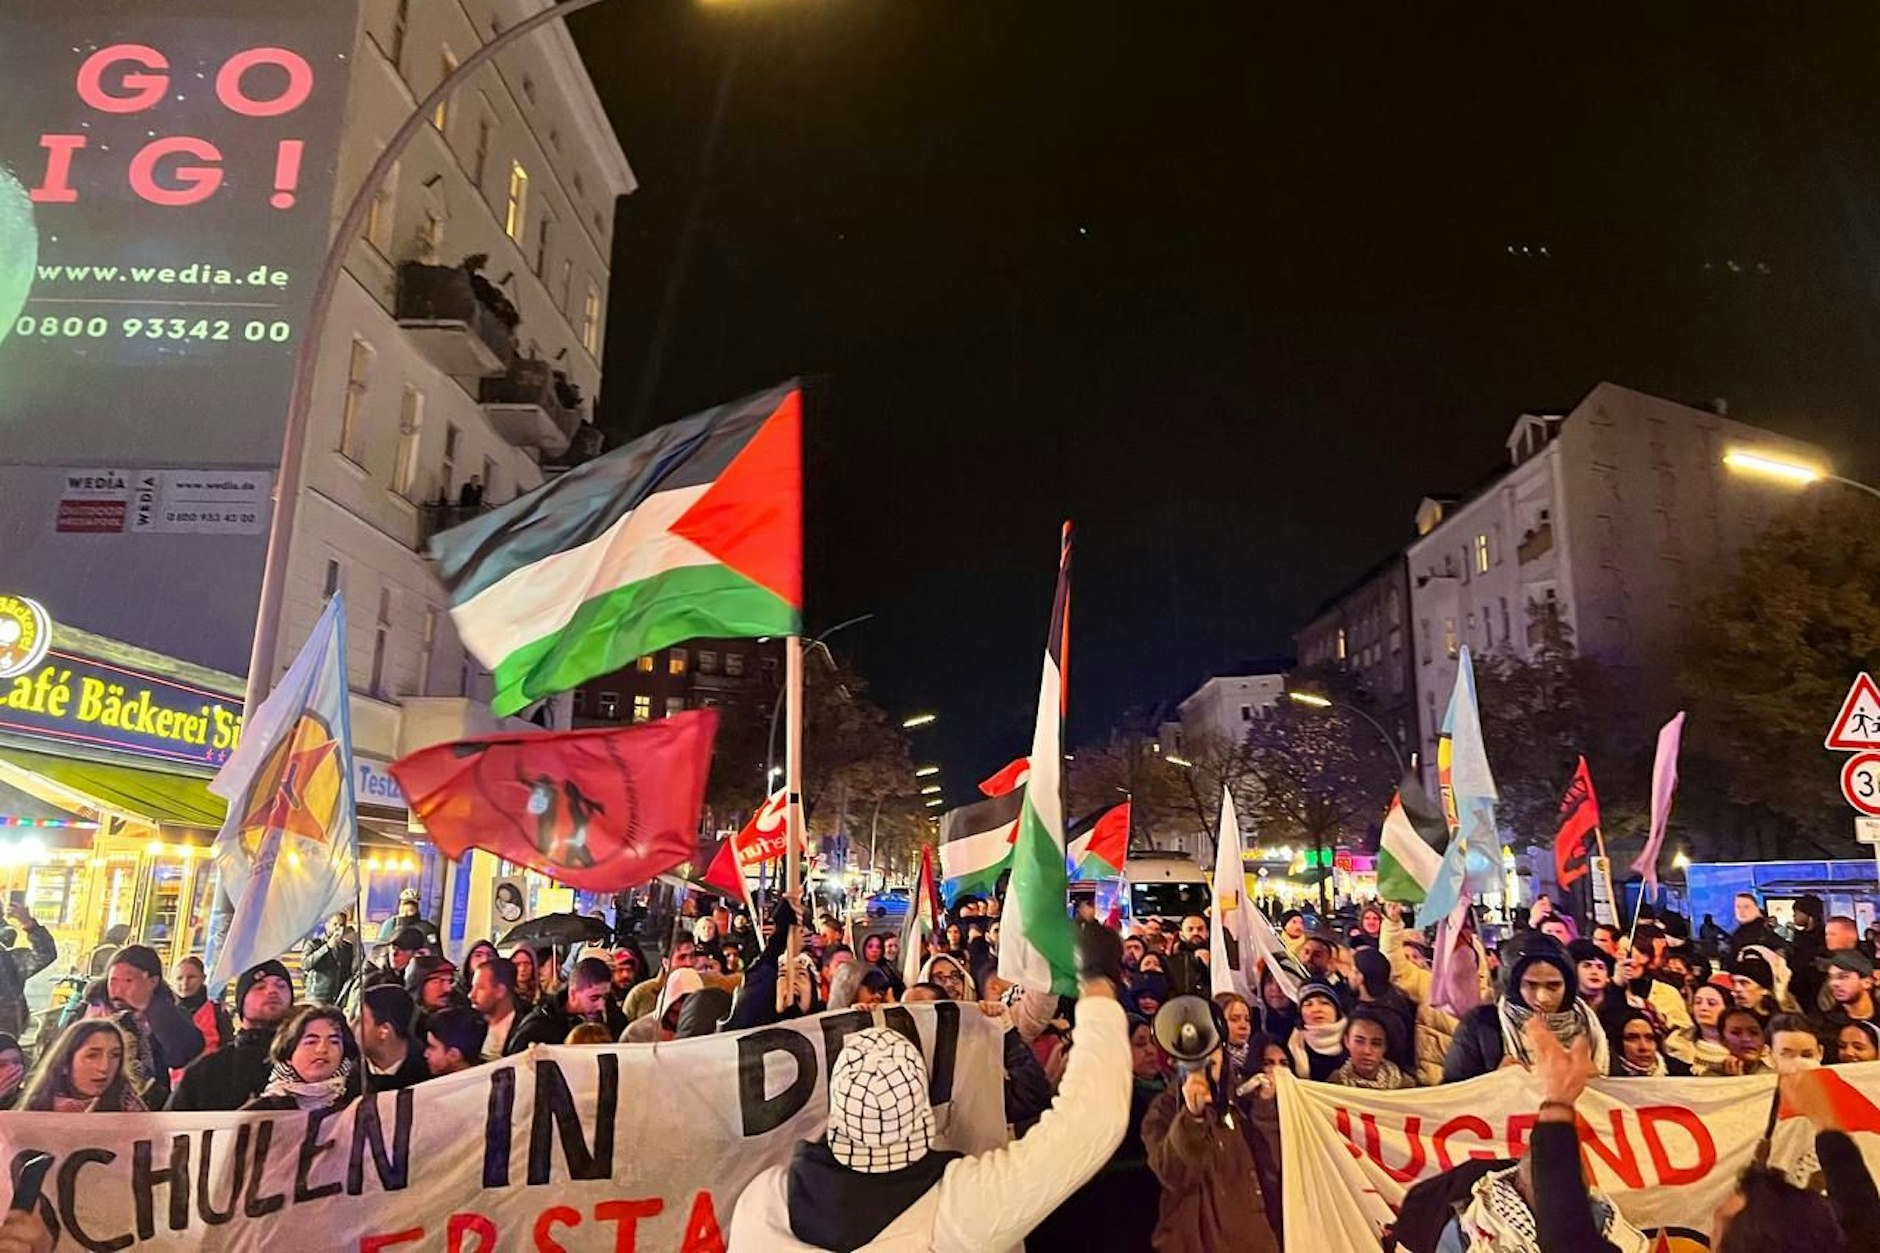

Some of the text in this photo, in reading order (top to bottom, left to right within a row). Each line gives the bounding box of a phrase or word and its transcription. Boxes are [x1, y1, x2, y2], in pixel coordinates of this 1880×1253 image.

[37, 263, 289, 286] www.wedia.de
[15, 315, 290, 342] 0800 93342 00
[0, 666, 71, 717] afé
[77, 676, 212, 745] Bäckerei
[1857, 771, 1880, 797] 3
[482, 1052, 619, 1188] IN
